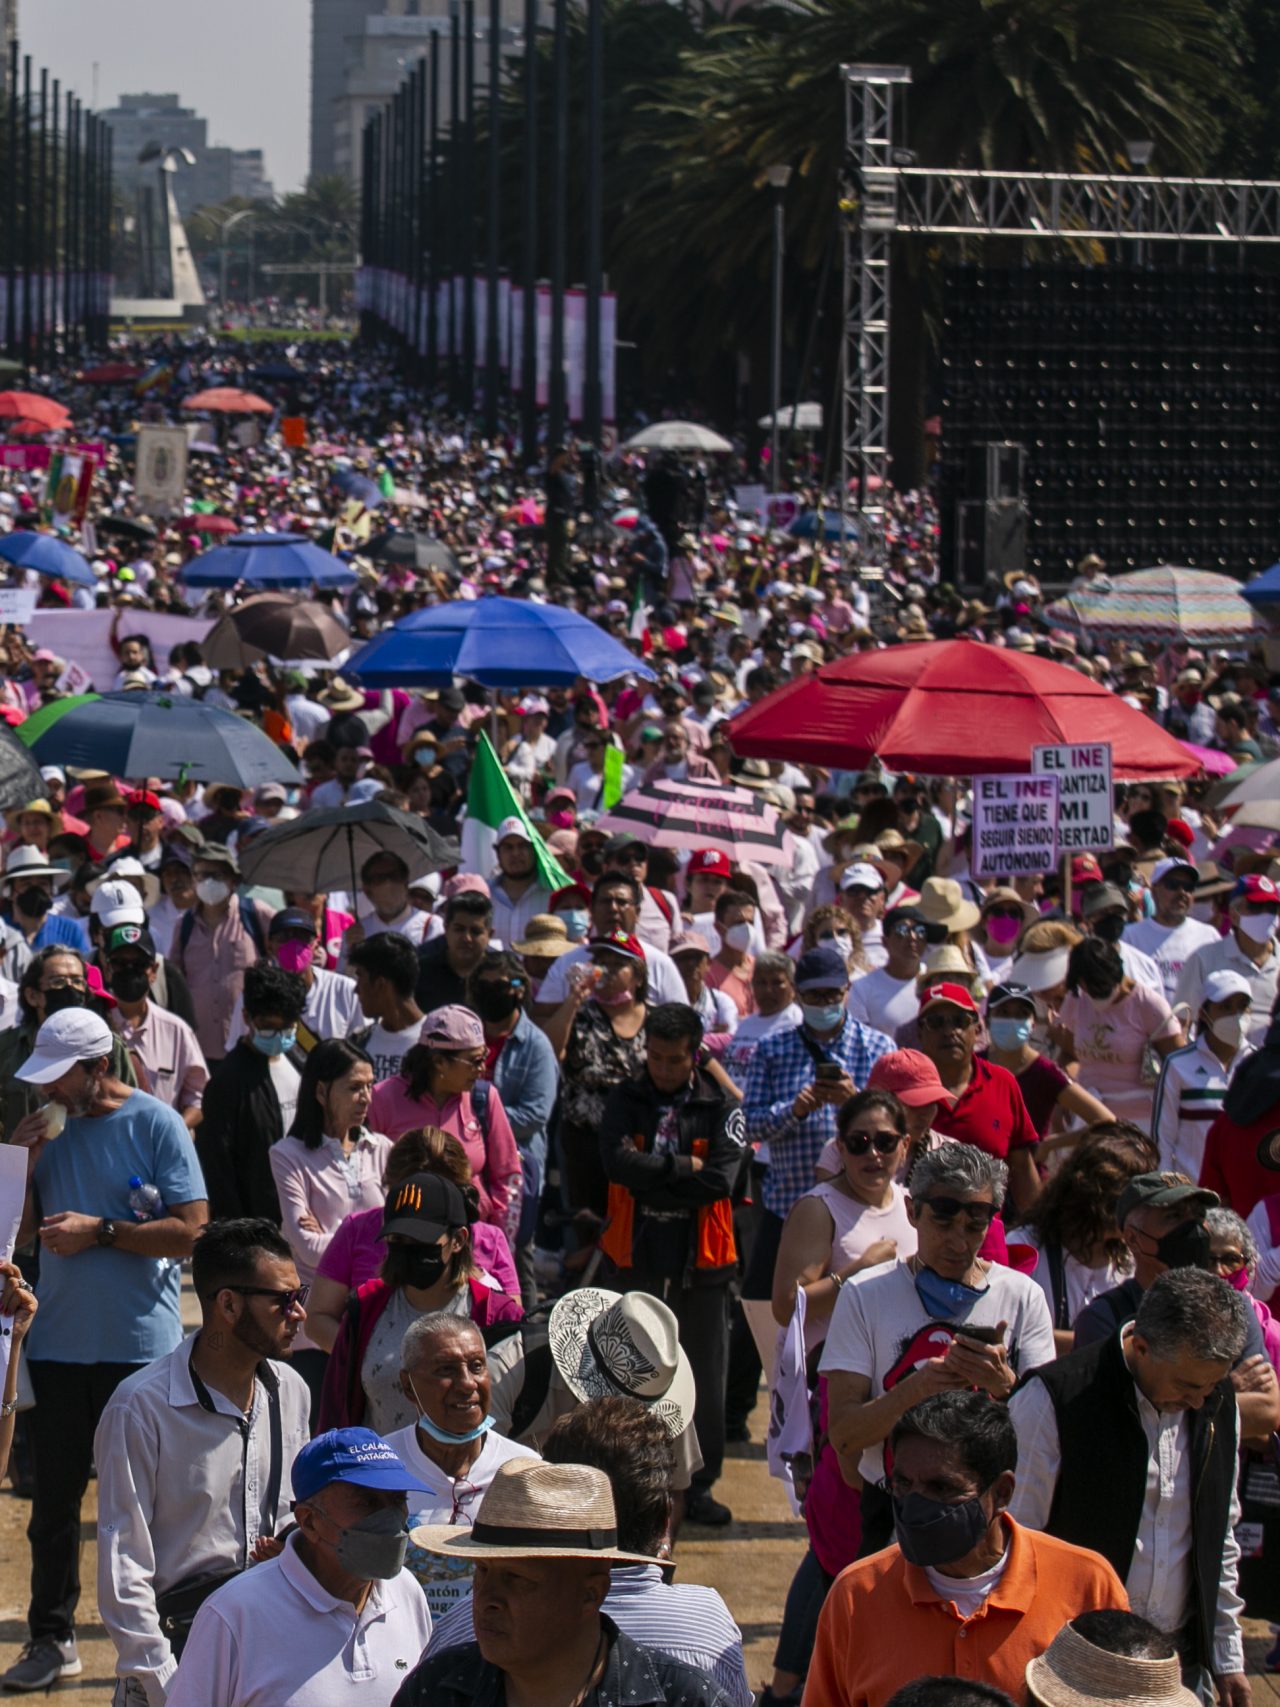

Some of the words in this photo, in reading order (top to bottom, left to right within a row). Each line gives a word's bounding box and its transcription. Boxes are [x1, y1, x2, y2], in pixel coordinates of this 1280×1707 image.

[1043, 751, 1065, 769] EL
[1072, 748, 1104, 767] INE
[982, 781, 1008, 799] EL
[1015, 780, 1052, 797] INE
[982, 805, 1018, 823] TIENE
[1021, 803, 1048, 822] QUE
[1059, 801, 1088, 821] MI
[980, 829, 1015, 848] SEGUIR
[1017, 827, 1053, 845] SIENDO
[349, 1445, 360, 1454] EL
